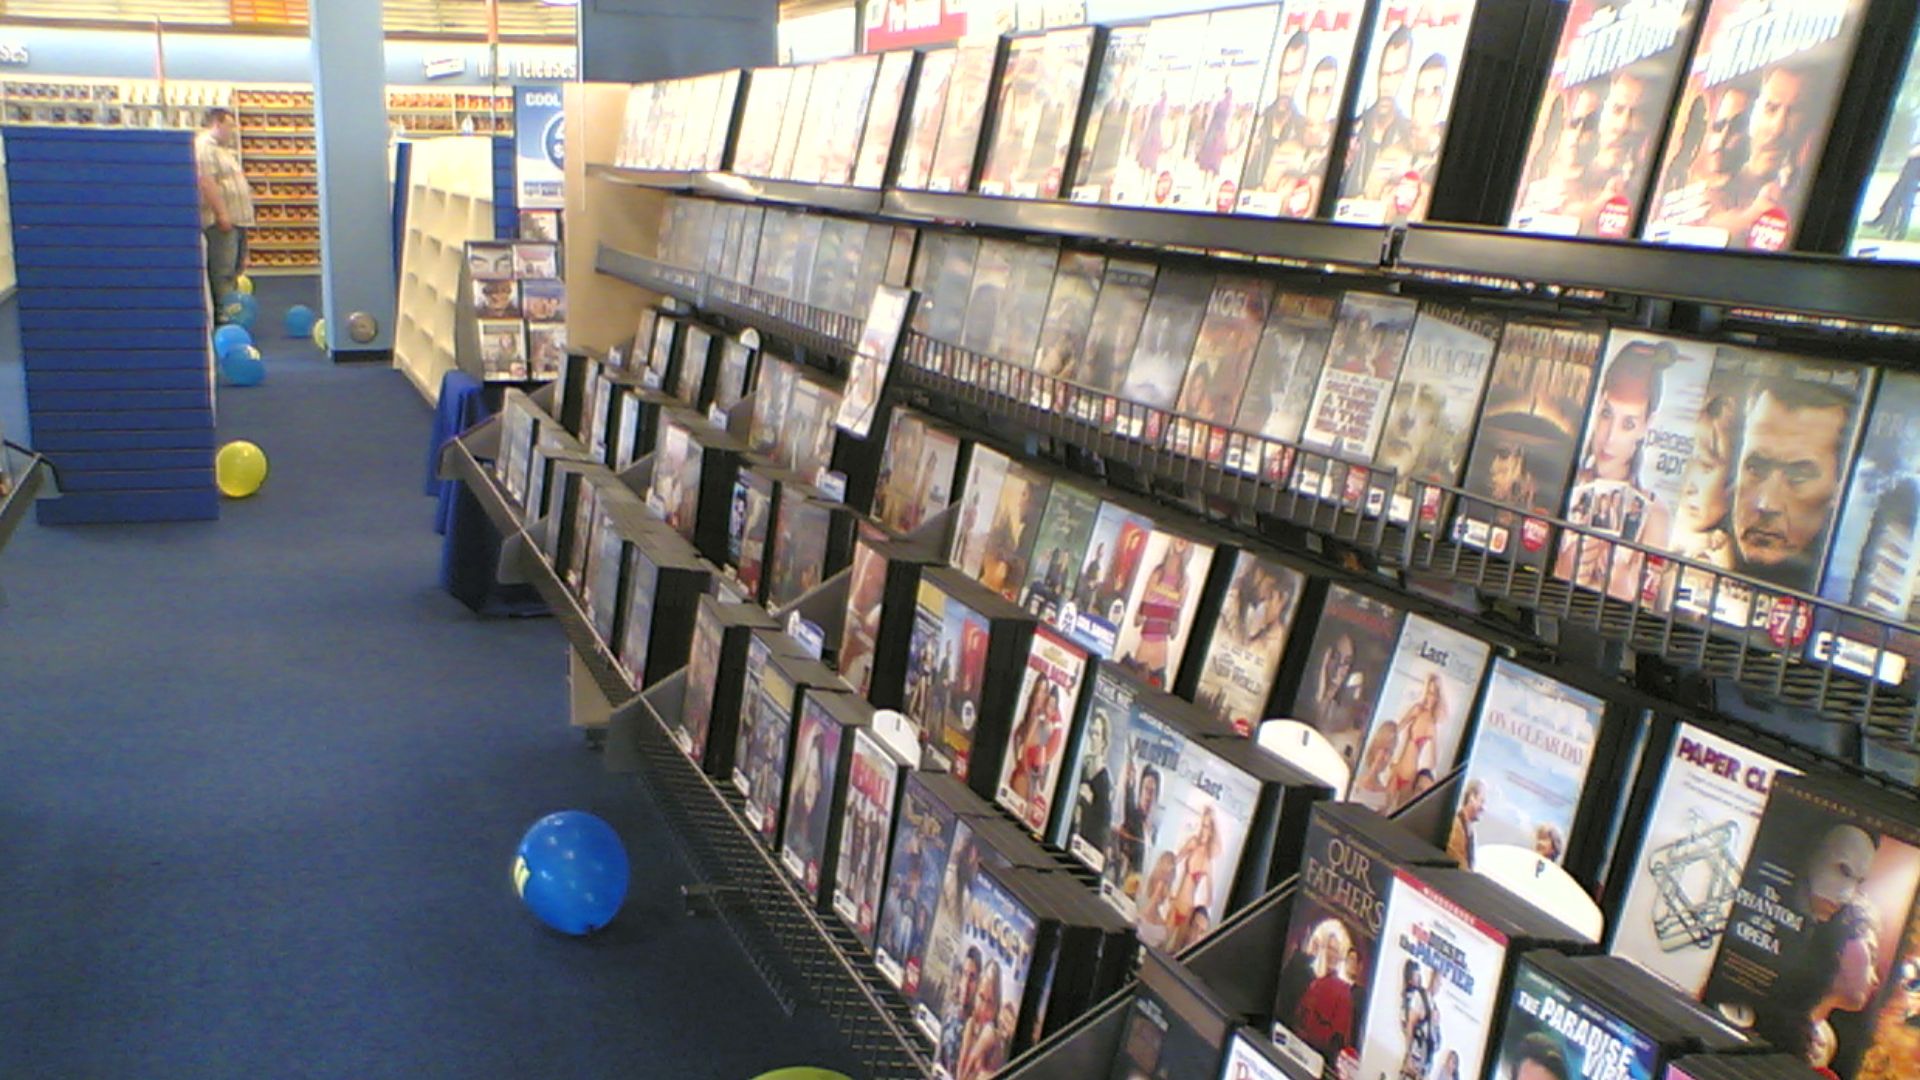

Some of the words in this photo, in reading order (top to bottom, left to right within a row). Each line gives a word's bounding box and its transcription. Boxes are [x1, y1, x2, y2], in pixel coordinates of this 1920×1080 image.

[1647, 429, 1695, 455] pieces
[1656, 453, 1688, 475] apr
[1420, 640, 1449, 668] Last
[1678, 736, 1742, 784] PAPER
[1196, 770, 1225, 801] Last
[1328, 838, 1377, 897] OUR
[1307, 857, 1386, 934] FATHERS
[1736, 888, 1804, 933] PHANTOM
[1736, 920, 1780, 956] OPERA
[1412, 941, 1475, 996] PACIFIER
[1518, 990, 1541, 1016] THE
[1539, 996, 1637, 1070] PARADISE
